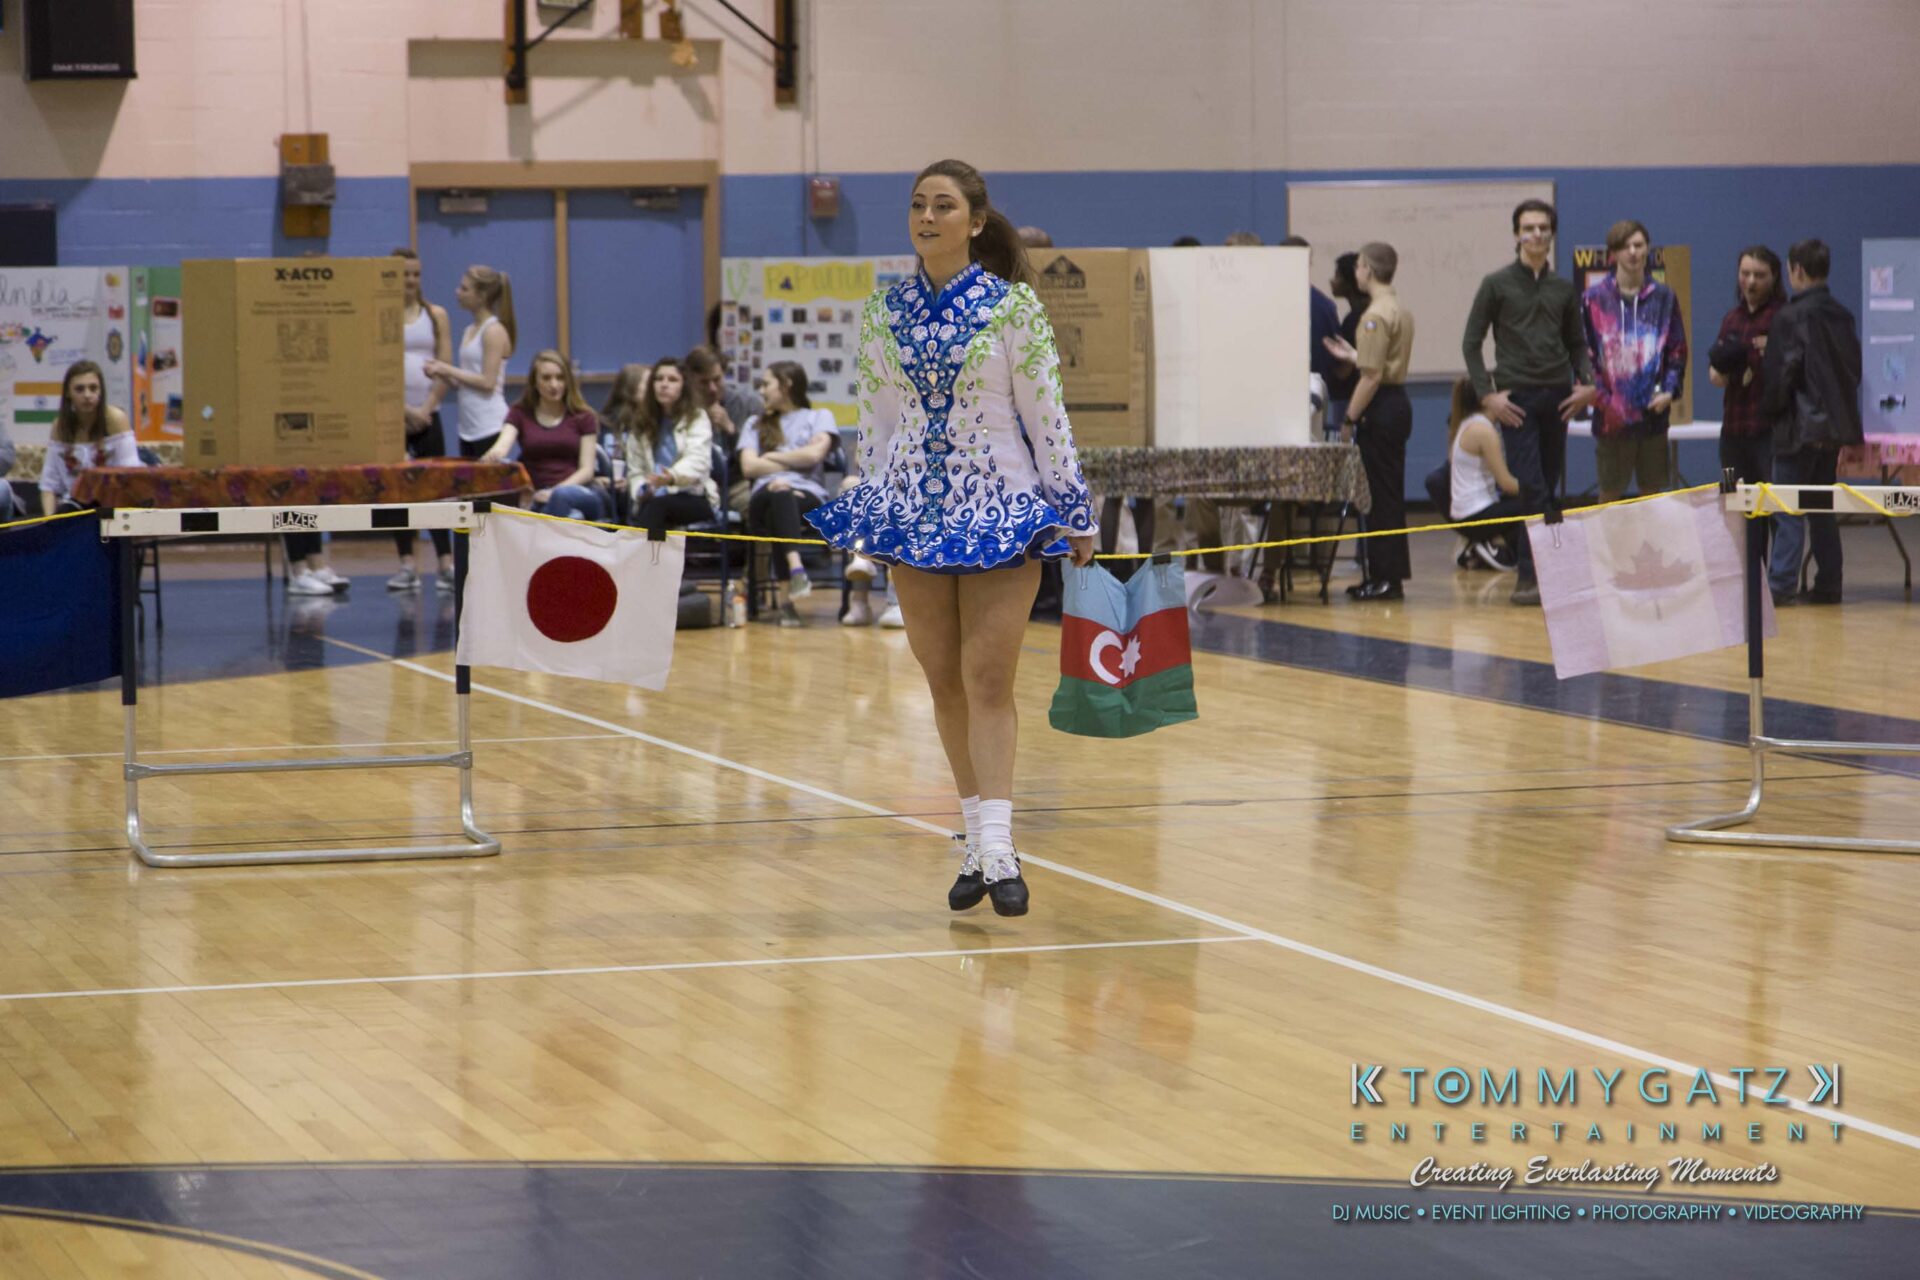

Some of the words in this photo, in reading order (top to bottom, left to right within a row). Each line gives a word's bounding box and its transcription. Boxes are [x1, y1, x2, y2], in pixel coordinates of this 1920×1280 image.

[275, 267, 334, 281] X-ACTO
[1883, 492, 1920, 509] BLAZE
[272, 511, 319, 529] BLAZER
